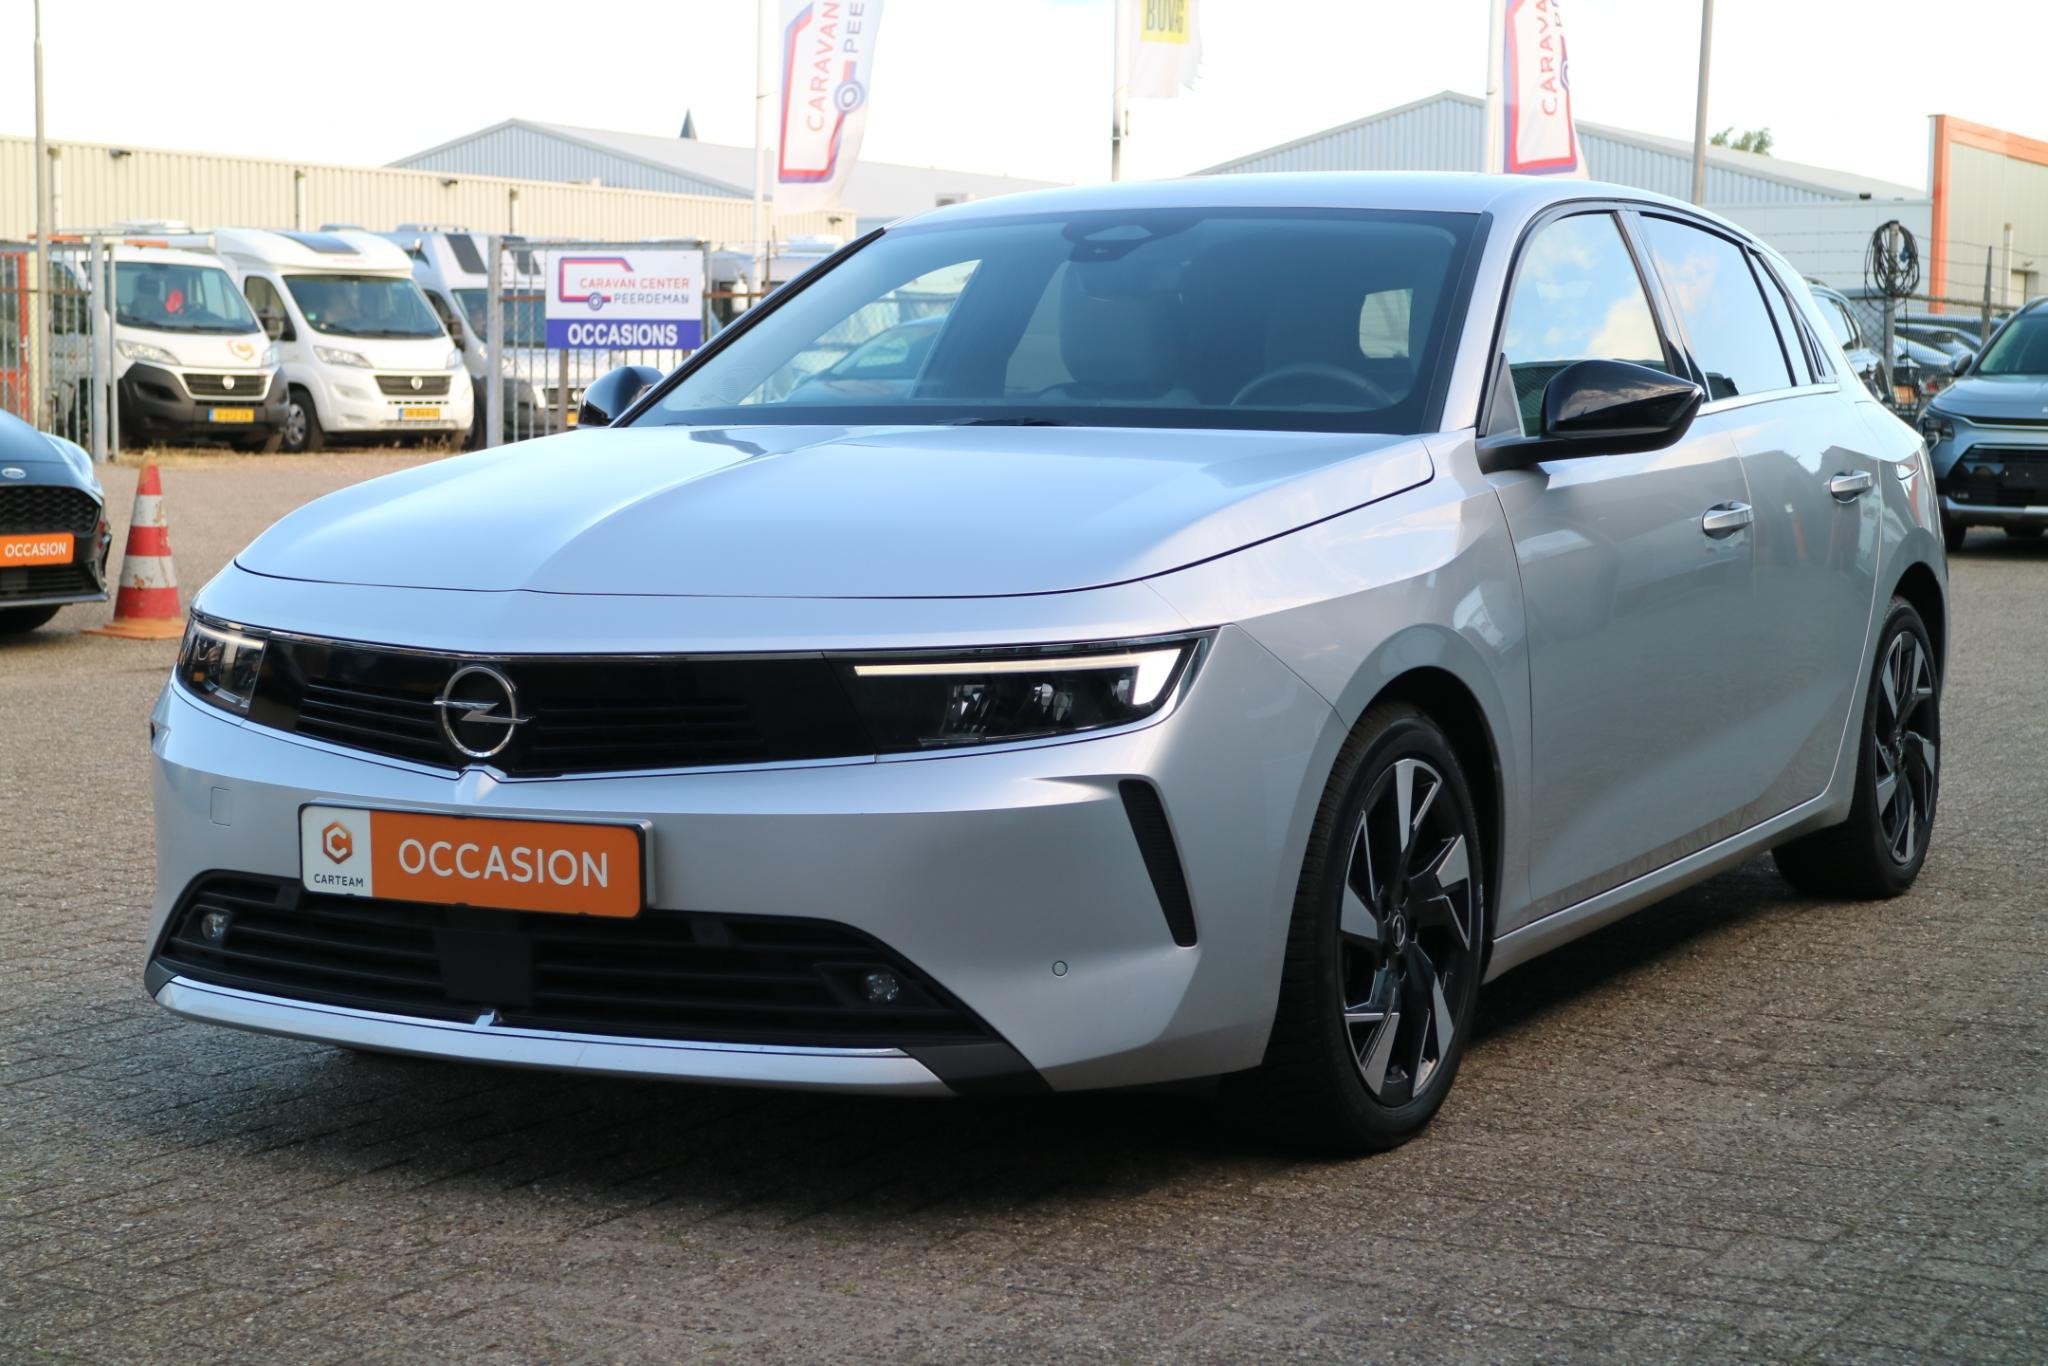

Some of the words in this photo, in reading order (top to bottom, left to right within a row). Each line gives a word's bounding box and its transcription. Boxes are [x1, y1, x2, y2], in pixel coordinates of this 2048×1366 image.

[806, 1, 840, 132] CARAVAN
[580, 277, 635, 288] CARAVAN
[640, 277, 689, 289] CENTER
[614, 293, 689, 304] PEERDEMAN
[567, 323, 678, 345] OCCASIONS
[4, 542, 67, 557] OCCASION
[398, 839, 608, 888] OCCASION
[314, 873, 364, 887] CARTEAM
